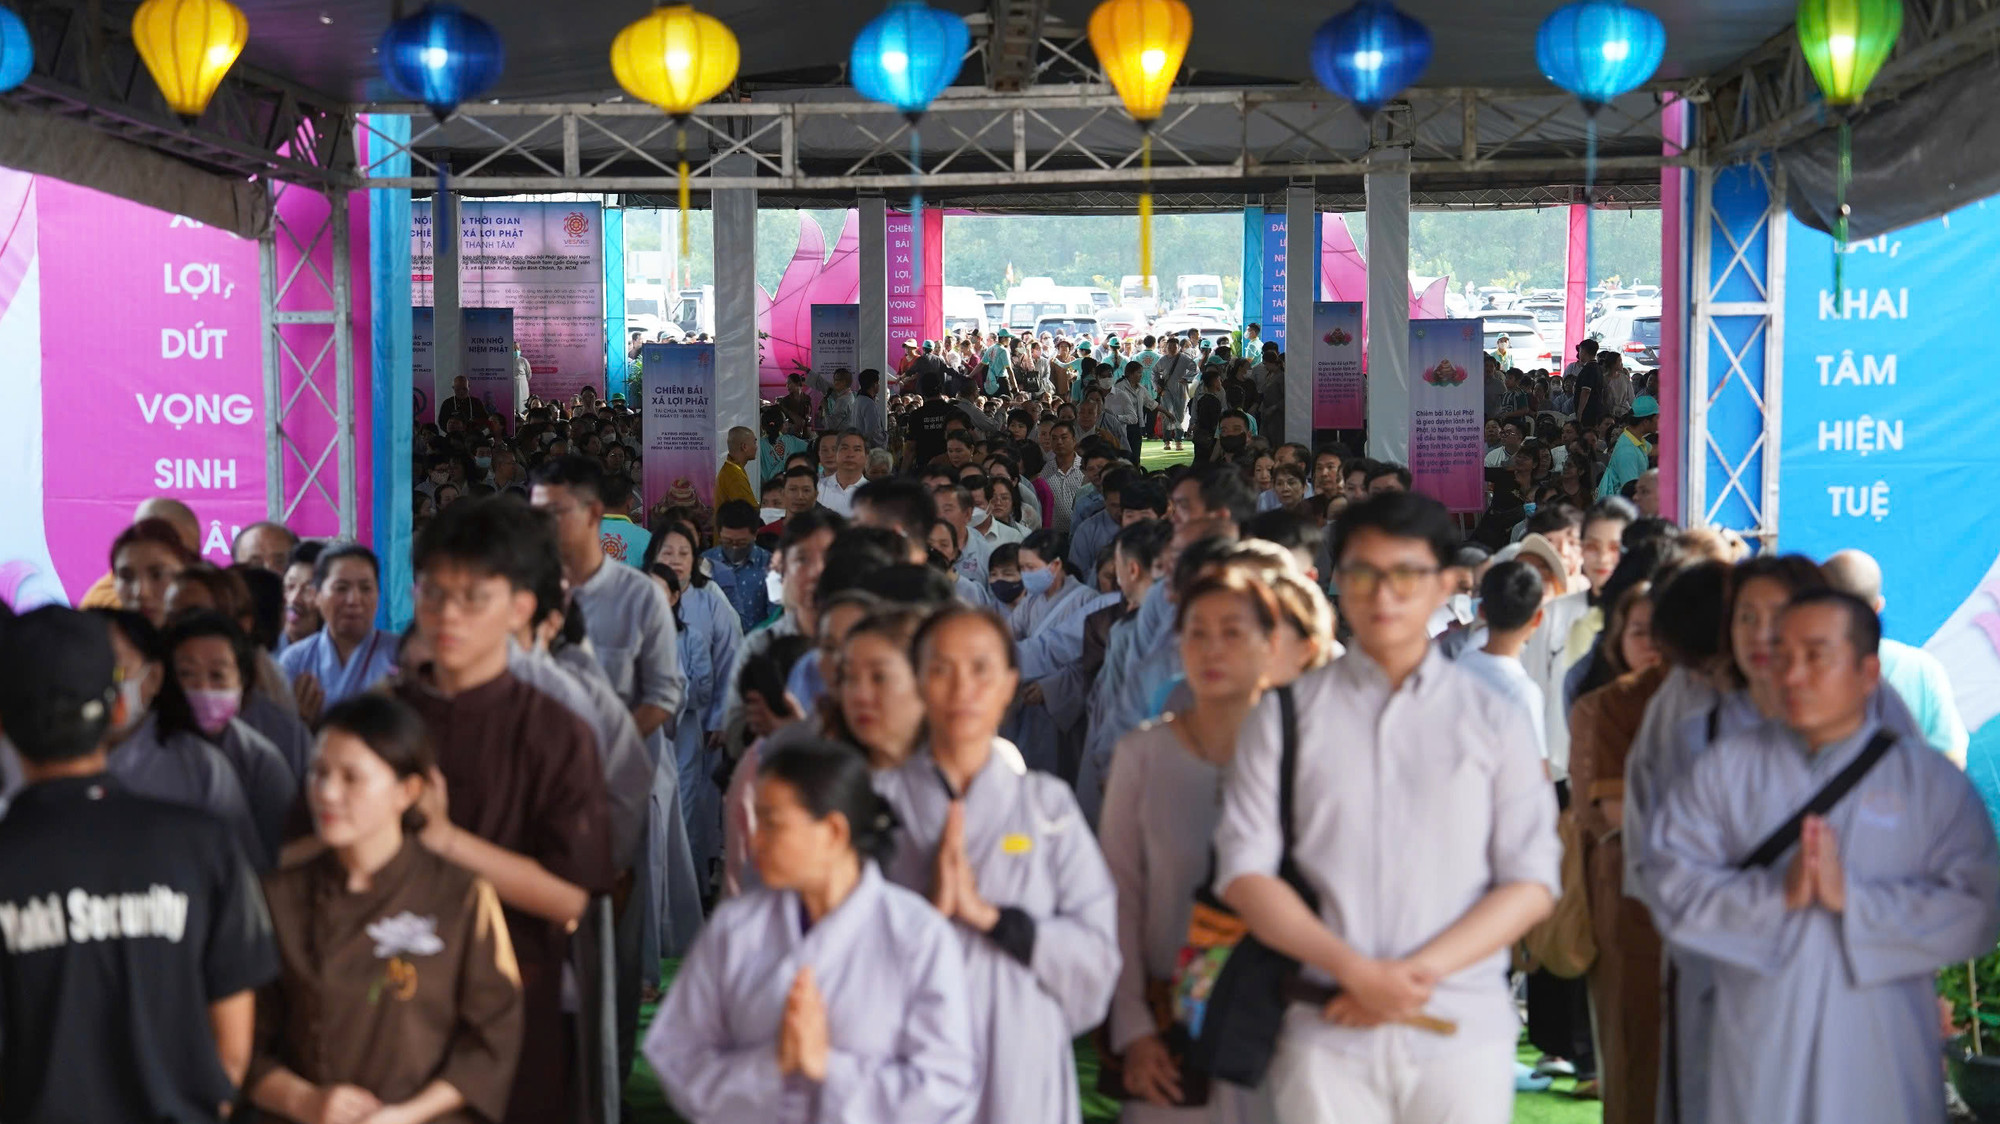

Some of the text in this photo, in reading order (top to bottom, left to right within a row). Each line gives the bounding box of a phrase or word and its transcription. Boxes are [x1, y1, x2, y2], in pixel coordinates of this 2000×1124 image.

[469, 215, 492, 225] THỜI
[495, 217, 521, 225] GIAN
[480, 229, 496, 239] LỢI
[499, 228, 524, 239] PHẬT
[888, 224, 915, 233] CHIÊM
[465, 240, 495, 249] THANH
[496, 240, 516, 249] TÂM
[894, 270, 912, 280] LỢI,
[164, 262, 235, 301] LỢI,
[894, 284, 910, 294] DỨT
[889, 301, 916, 311] VỌNG
[1818, 287, 1909, 321] KHAI
[892, 316, 913, 324] SINH
[891, 329, 917, 338] CHÂN
[161, 320, 228, 360] DỨT
[489, 345, 509, 354] PHẬT
[1815, 349, 1898, 386] TÂM
[655, 384, 685, 395] CHIÊM
[668, 396, 683, 407] LỢI
[685, 395, 709, 407] PHẬT
[135, 392, 254, 431] VỌNG
[1817, 414, 1904, 457] HIỆN
[154, 457, 237, 490] SINH
[1826, 480, 1891, 523] TUỆ
[67, 884, 189, 943] Security
